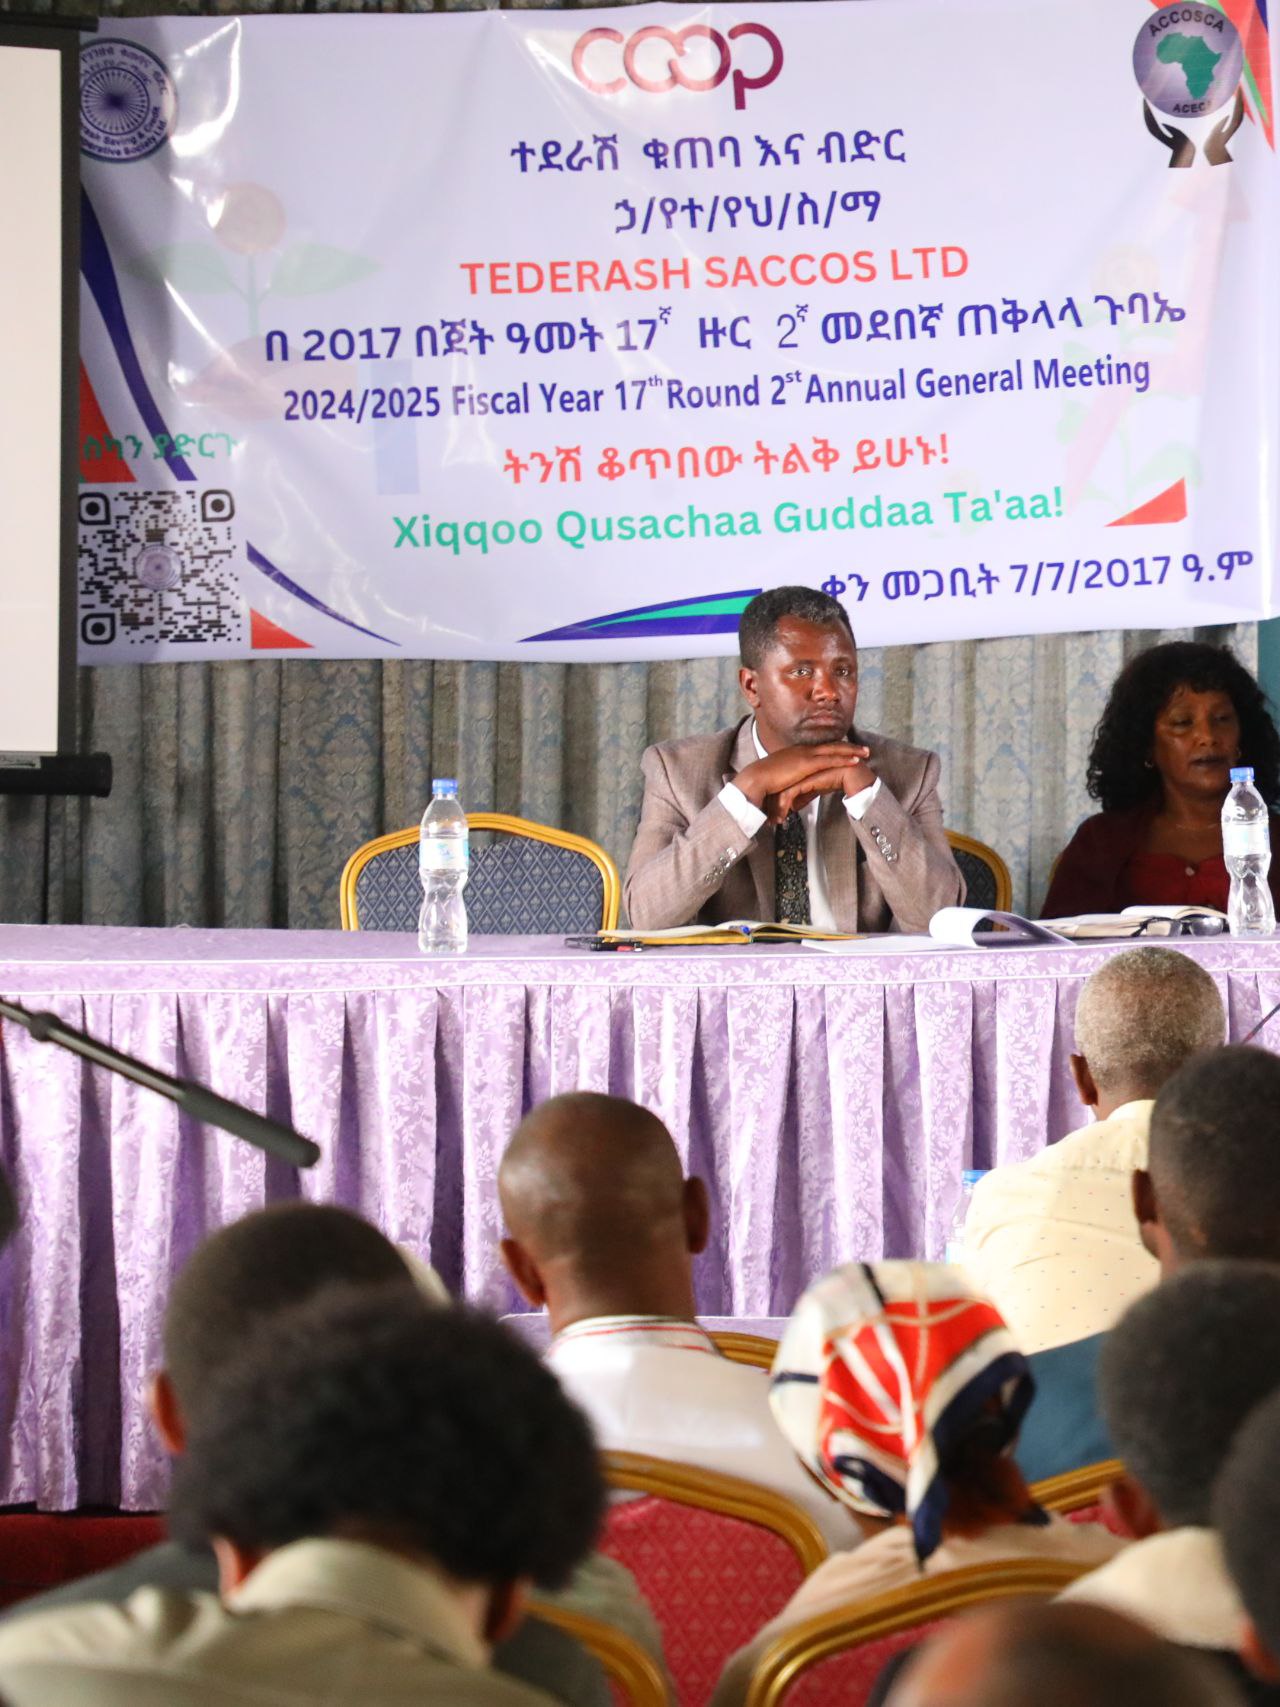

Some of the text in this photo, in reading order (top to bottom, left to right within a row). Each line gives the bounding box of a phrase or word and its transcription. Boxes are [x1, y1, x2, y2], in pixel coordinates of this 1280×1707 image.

[1149, 9, 1224, 36] ACCOSCA
[510, 129, 906, 173] ተደራሽ ቁጠባ እና ብድር
[460, 246, 968, 295] TEDERASH SACCOS LTD
[266, 330, 288, 361] በ
[303, 327, 401, 361] 2017
[416, 318, 494, 357] በጀት
[506, 317, 604, 354] ዓመት
[699, 316, 751, 349] ዙር
[822, 303, 944, 344] መደበኛ
[958, 297, 1083, 336] ጠቅላላ
[1094, 292, 1186, 325] ጉባኤ
[284, 387, 440, 424] 2024/2025
[452, 382, 529, 415] Fiscal
[539, 383, 604, 413] Year
[667, 374, 760, 409] Round
[805, 368, 906, 404] Annual
[916, 359, 1023, 398] General
[1034, 354, 1150, 393] Meeting
[504, 433, 949, 484] ትንሽ ቆጥበው ትልቅ ይሁኑ!
[393, 486, 1063, 556] Xiqqoo Qusachaa Guddaa Ta'aa!
[882, 563, 1000, 601] መጋቢት
[1009, 556, 1171, 596] 7/7/2017
[1182, 551, 1253, 582] ዓ.ም
